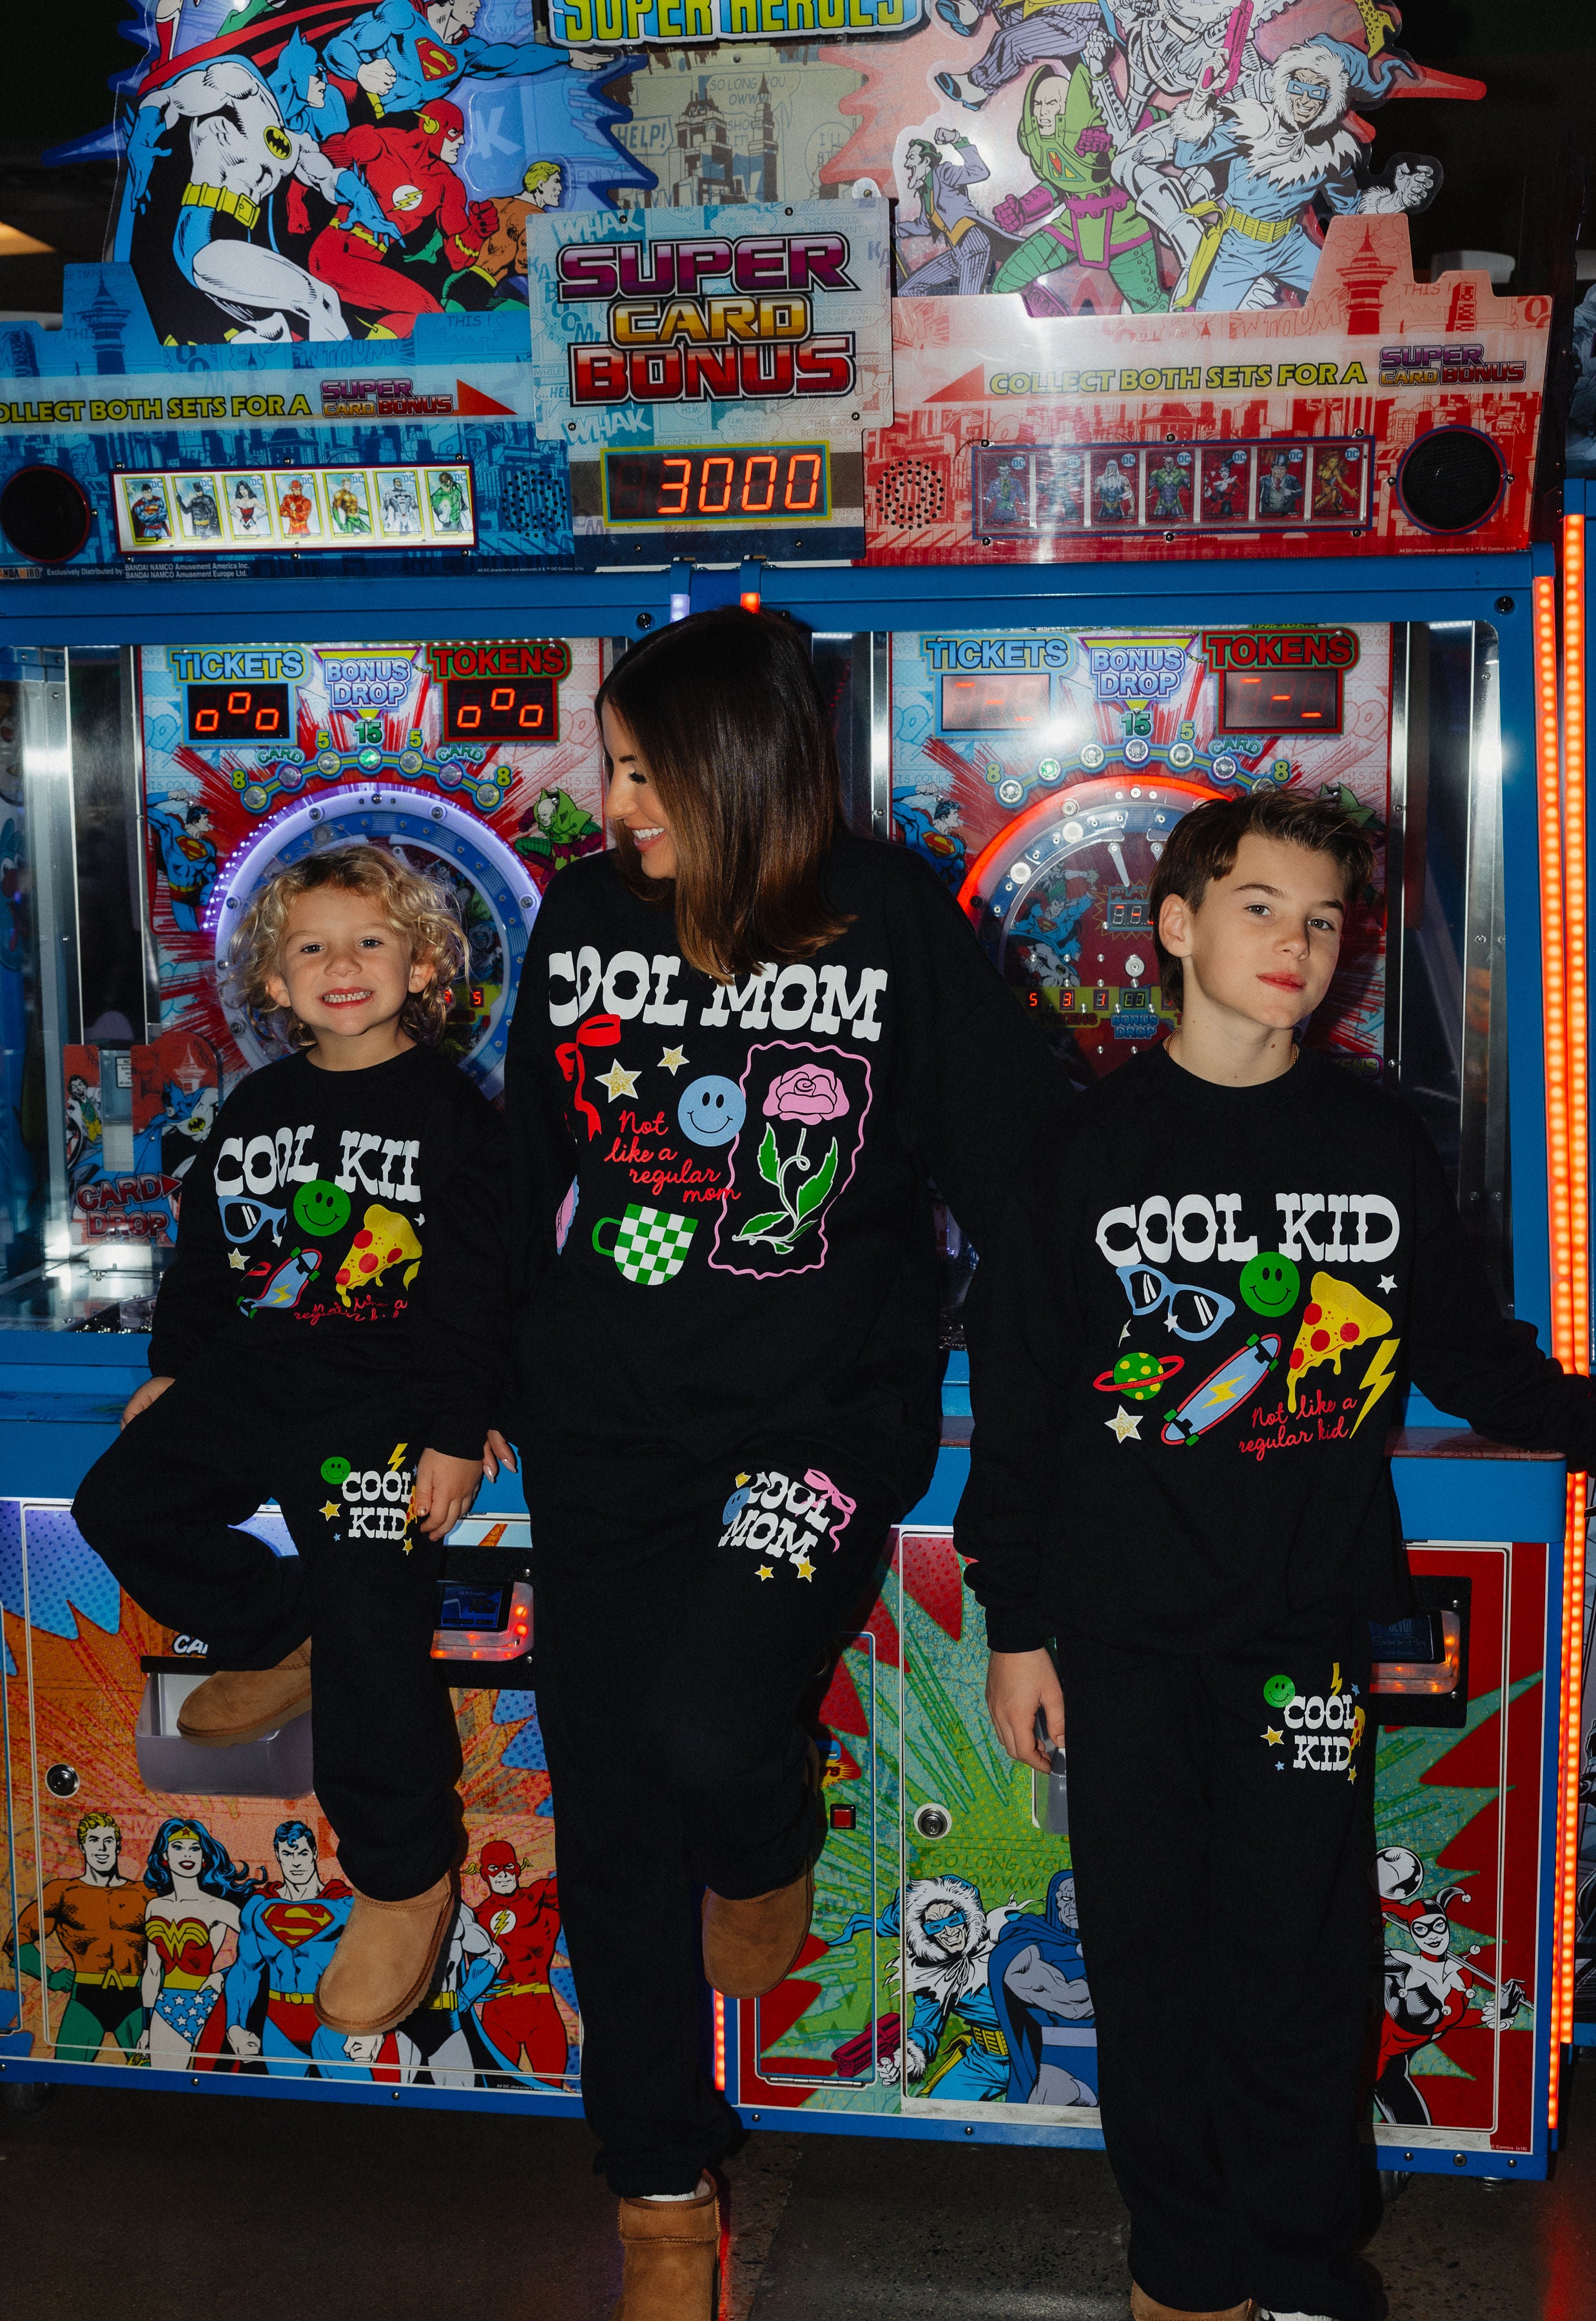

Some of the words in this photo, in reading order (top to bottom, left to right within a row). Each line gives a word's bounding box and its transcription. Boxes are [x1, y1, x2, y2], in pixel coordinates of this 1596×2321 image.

[564, 0, 714, 41] SUPER
[728, 0, 904, 34] HEROES
[616, 122, 667, 150] HELP!
[553, 209, 644, 245] WHAK
[557, 231, 861, 303] SUPER
[1402, 283, 1442, 296] THIS
[447, 315, 483, 328] THIS
[608, 294, 813, 349] CARD
[568, 331, 857, 407] BONUS
[1380, 344, 1484, 369] SUPER
[989, 369, 1116, 395] COLLECT
[1119, 366, 1201, 391] BOTH
[1206, 364, 1272, 388] SETS
[1278, 362, 1338, 386] FOR
[1339, 361, 1367, 385] A
[1379, 367, 1440, 386] CARD
[1439, 360, 1527, 385] BONUS
[320, 377, 414, 400] SUPER
[90, 398, 162, 420] BOTH
[167, 397, 226, 418] SETS
[231, 395, 288, 417] FOR
[287, 393, 312, 416] A
[322, 399, 376, 418] CARD
[376, 394, 453, 416] BONUS
[561, 408, 653, 446] WHAK
[1012, 458, 1026, 468] DC
[1122, 455, 1135, 465] DC
[1178, 454, 1191, 464] DC
[1232, 453, 1247, 462] DC
[1289, 451, 1303, 460] DC
[1345, 449, 1359, 459] DC
[657, 454, 821, 514] 3000
[46, 568, 80, 577] Exclusively
[81, 567, 112, 576] Distributed
[150, 563, 174, 571] NAMCO
[213, 570, 235, 578] Europe
[433, 646, 565, 676] TOKENS
[926, 638, 1069, 669] TICKETS
[1093, 647, 1183, 671] BONUS
[1208, 634, 1352, 667] TOKENS
[173, 651, 304, 680] TICKETS
[325, 658, 411, 683] BONUS
[332, 681, 407, 707] DROP
[1100, 672, 1180, 697] DROP
[355, 721, 382, 744] 15
[1120, 712, 1153, 737] 15
[1180, 722, 1195, 741] 5
[316, 731, 331, 749] 5
[409, 730, 423, 748] 5
[1209, 737, 1263, 756] CARD
[257, 749, 305, 764] CARD
[438, 743, 485, 763] CARD
[231, 769, 248, 790] 8
[496, 767, 512, 788] 8
[986, 762, 1002, 784] 8
[1272, 760, 1290, 782] 8
[473, 991, 482, 1004] 5
[700, 961, 888, 1042] MOM
[1029, 993, 1038, 1006] 5
[1063, 993, 1072, 1006] 3
[1111, 1014, 1159, 1026] BONUS
[1114, 1026, 1157, 1040] DROP
[618, 1109, 670, 1137] Not
[213, 1124, 320, 1199] COOL
[603, 1136, 656, 1164] like
[657, 1147, 678, 1162] a
[628, 1158, 721, 1196] regular
[75, 1173, 161, 1211] CARD
[683, 1185, 741, 1203] mom
[86, 1211, 169, 1239] DROP
[1095, 1193, 1259, 1269] COOL
[1275, 1192, 1401, 1264] KID
[1252, 1401, 1289, 1428] Not
[1295, 1389, 1336, 1420] like
[1342, 1397, 1358, 1411] a
[1238, 1424, 1314, 1462] regular
[1318, 1415, 1349, 1442] kid
[341, 1471, 413, 1504] COOL
[746, 1471, 831, 1534] COOL
[348, 1506, 407, 1541] KID
[717, 1509, 819, 1564] MOM
[1283, 1694, 1356, 1730] COOL
[1292, 1734, 1352, 1771] KID
